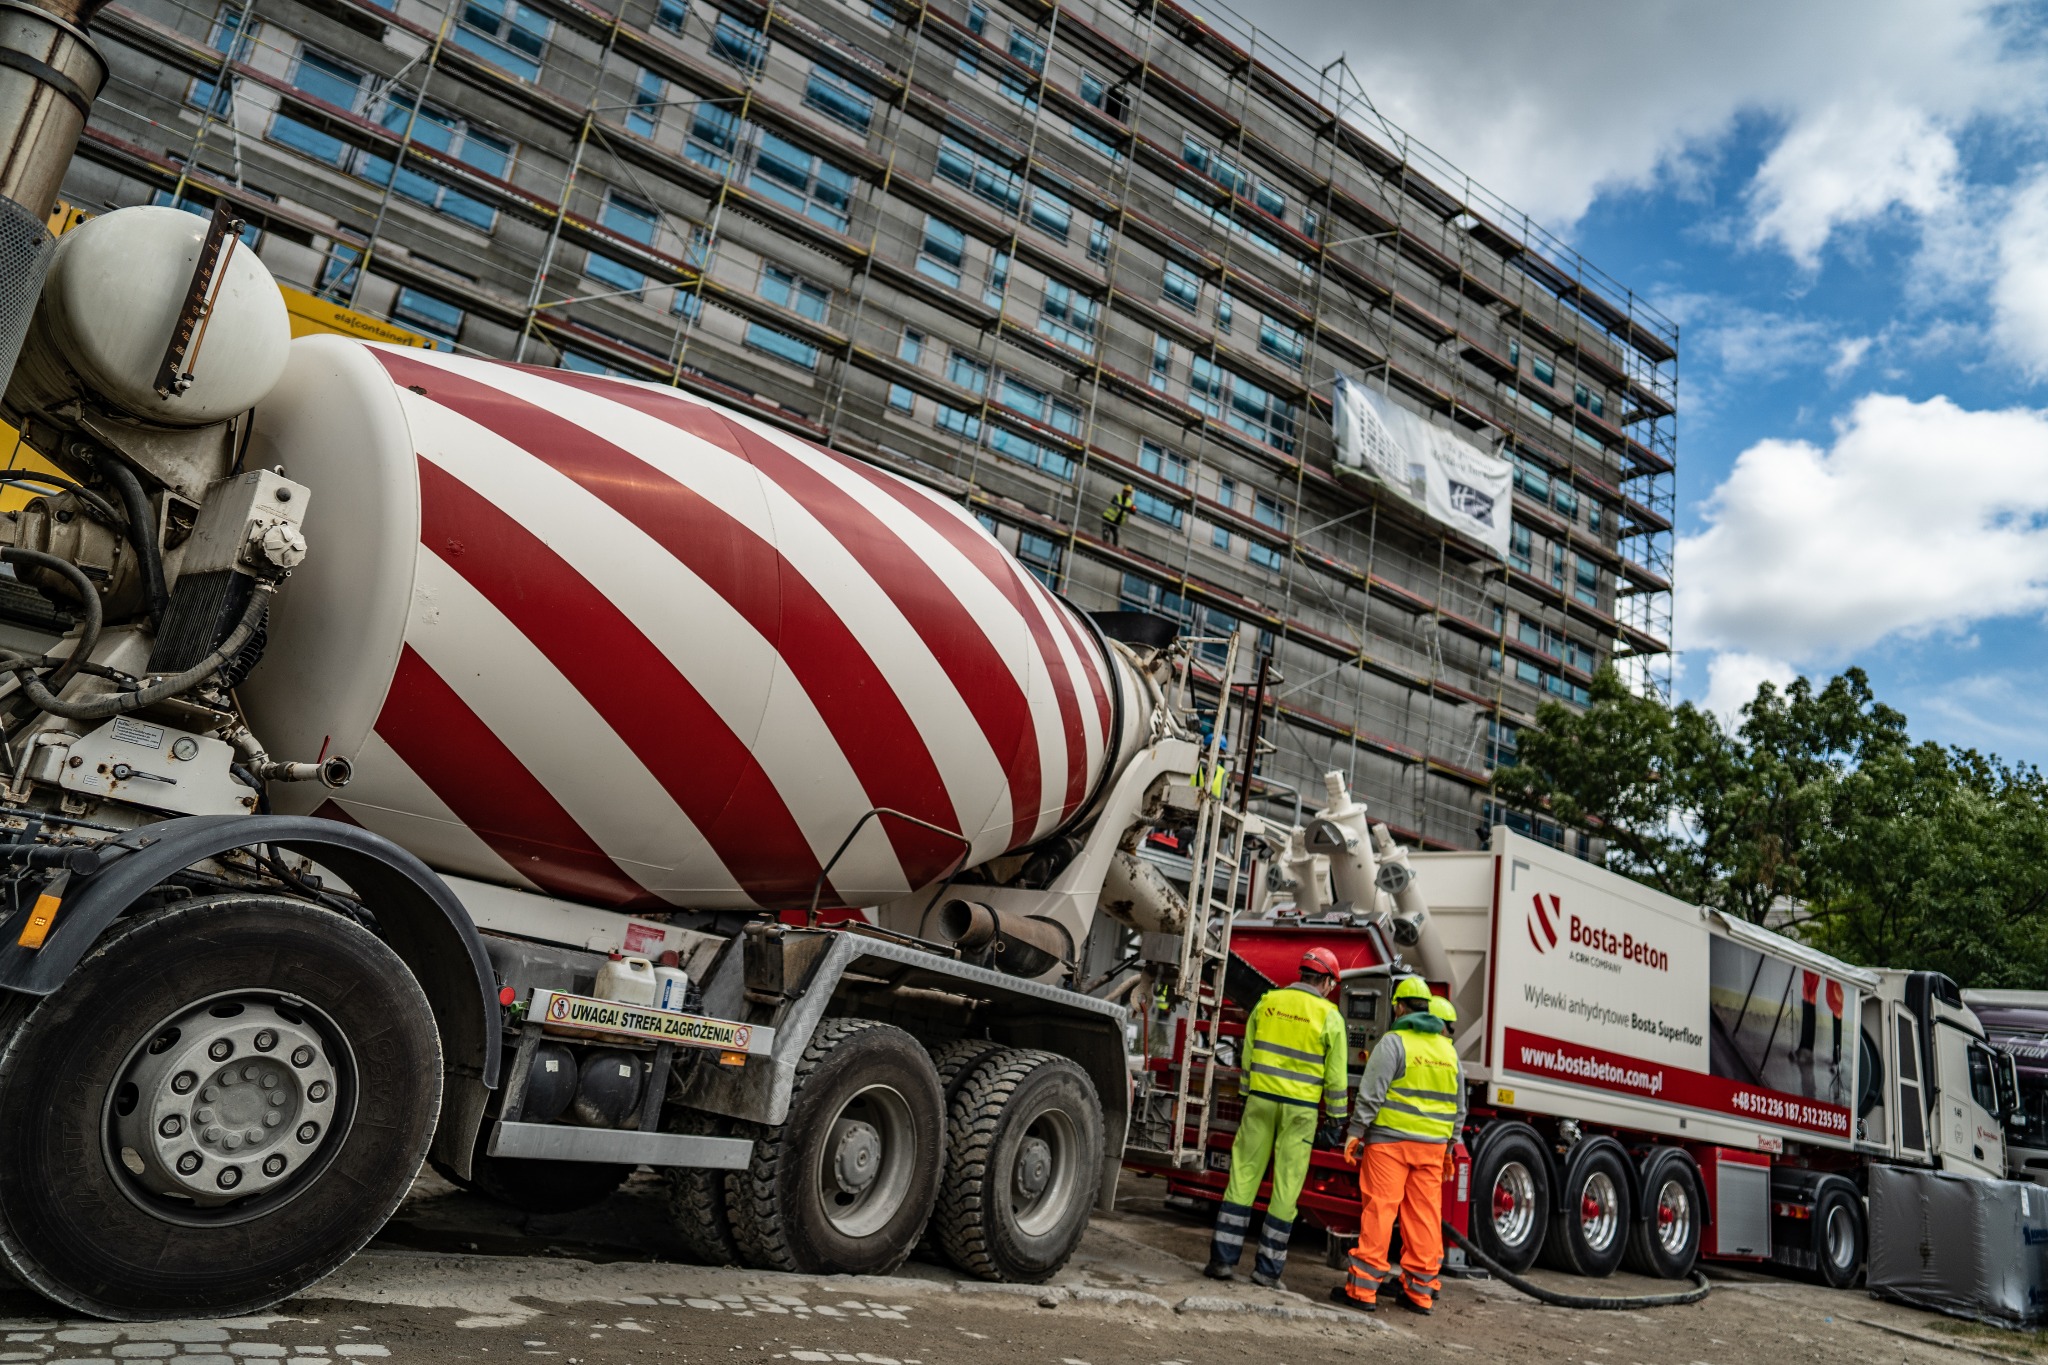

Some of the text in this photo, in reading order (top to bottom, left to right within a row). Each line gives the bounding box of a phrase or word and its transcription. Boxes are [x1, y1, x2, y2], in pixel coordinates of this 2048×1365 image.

[1575, 952, 1590, 964] CRH
[1590, 957, 1622, 974] COMPANY
[571, 1003, 734, 1044] UWAGA! STREFA ZAGROŻENIA!
[1524, 984, 1703, 1047] Wylewki anhydrytowe Bosta Superfloor
[1521, 1046, 1663, 1095] www.bostabeton.com.pl
[1731, 1091, 1847, 1132] +48 512 236 187, 512 235 936
